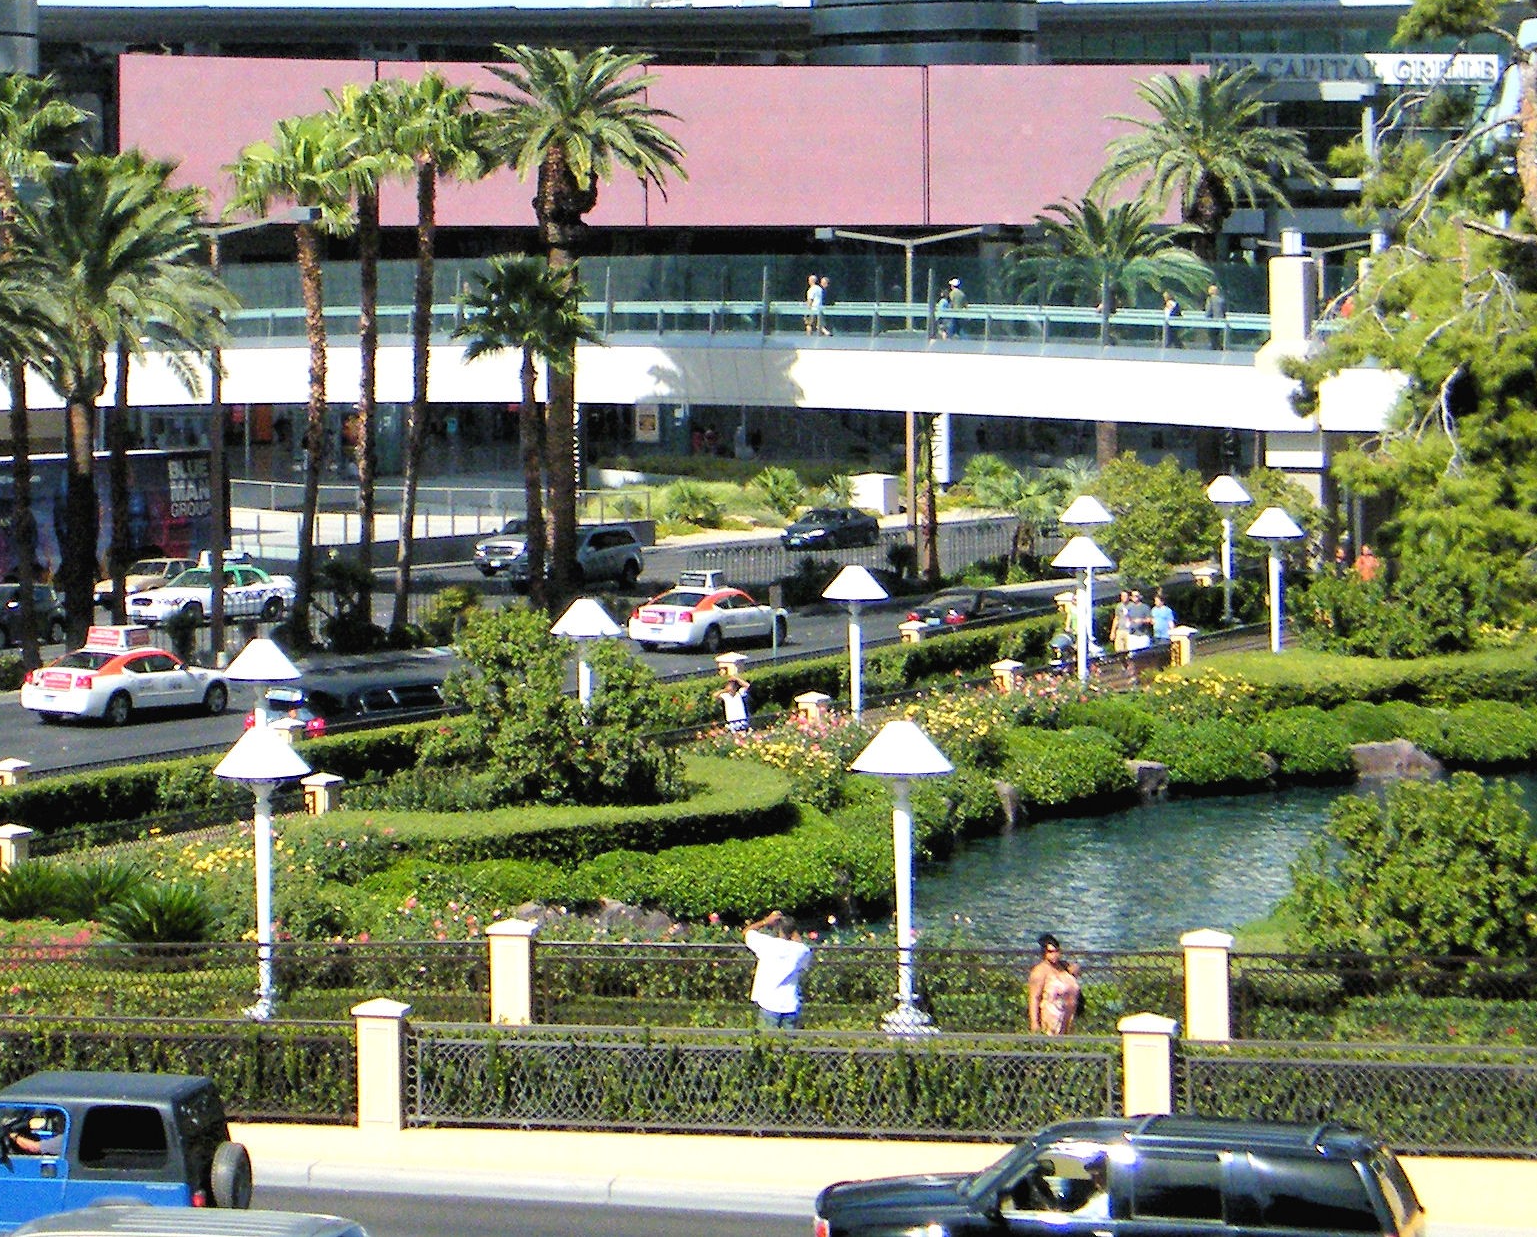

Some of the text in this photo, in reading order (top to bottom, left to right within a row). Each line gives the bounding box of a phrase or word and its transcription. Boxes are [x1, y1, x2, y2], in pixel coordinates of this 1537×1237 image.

[1264, 57, 1383, 81] CAPITAL
[1392, 59, 1497, 82] GRILLE
[167, 459, 210, 480] BLUE
[169, 480, 212, 502] MAN
